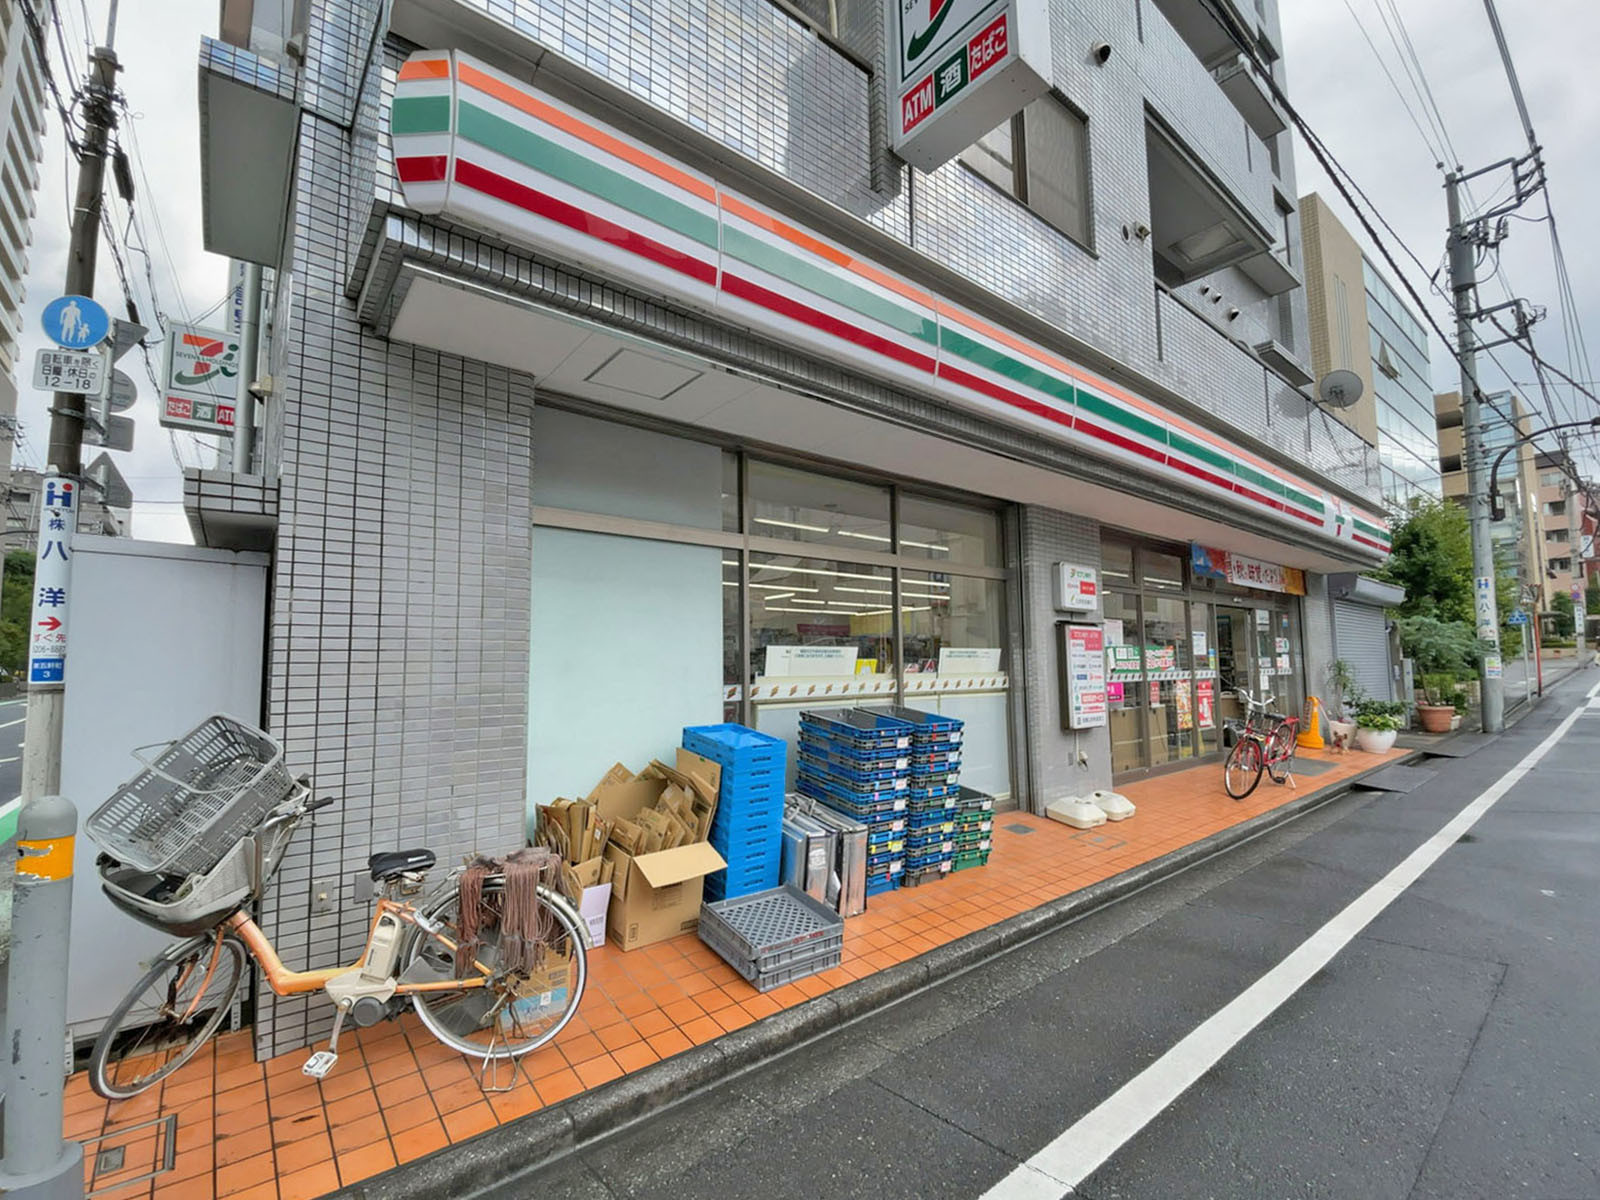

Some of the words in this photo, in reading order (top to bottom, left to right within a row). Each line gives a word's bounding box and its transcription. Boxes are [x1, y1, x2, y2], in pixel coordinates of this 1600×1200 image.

[904, 82, 933, 127] ATM
[940, 58, 963, 98] 酒
[969, 25, 1007, 73] たばこ
[168, 400, 191, 416] たばこ
[196, 405, 212, 419] 酒
[33, 633, 67, 643] すぐ先
[42, 670, 52, 678] 3
